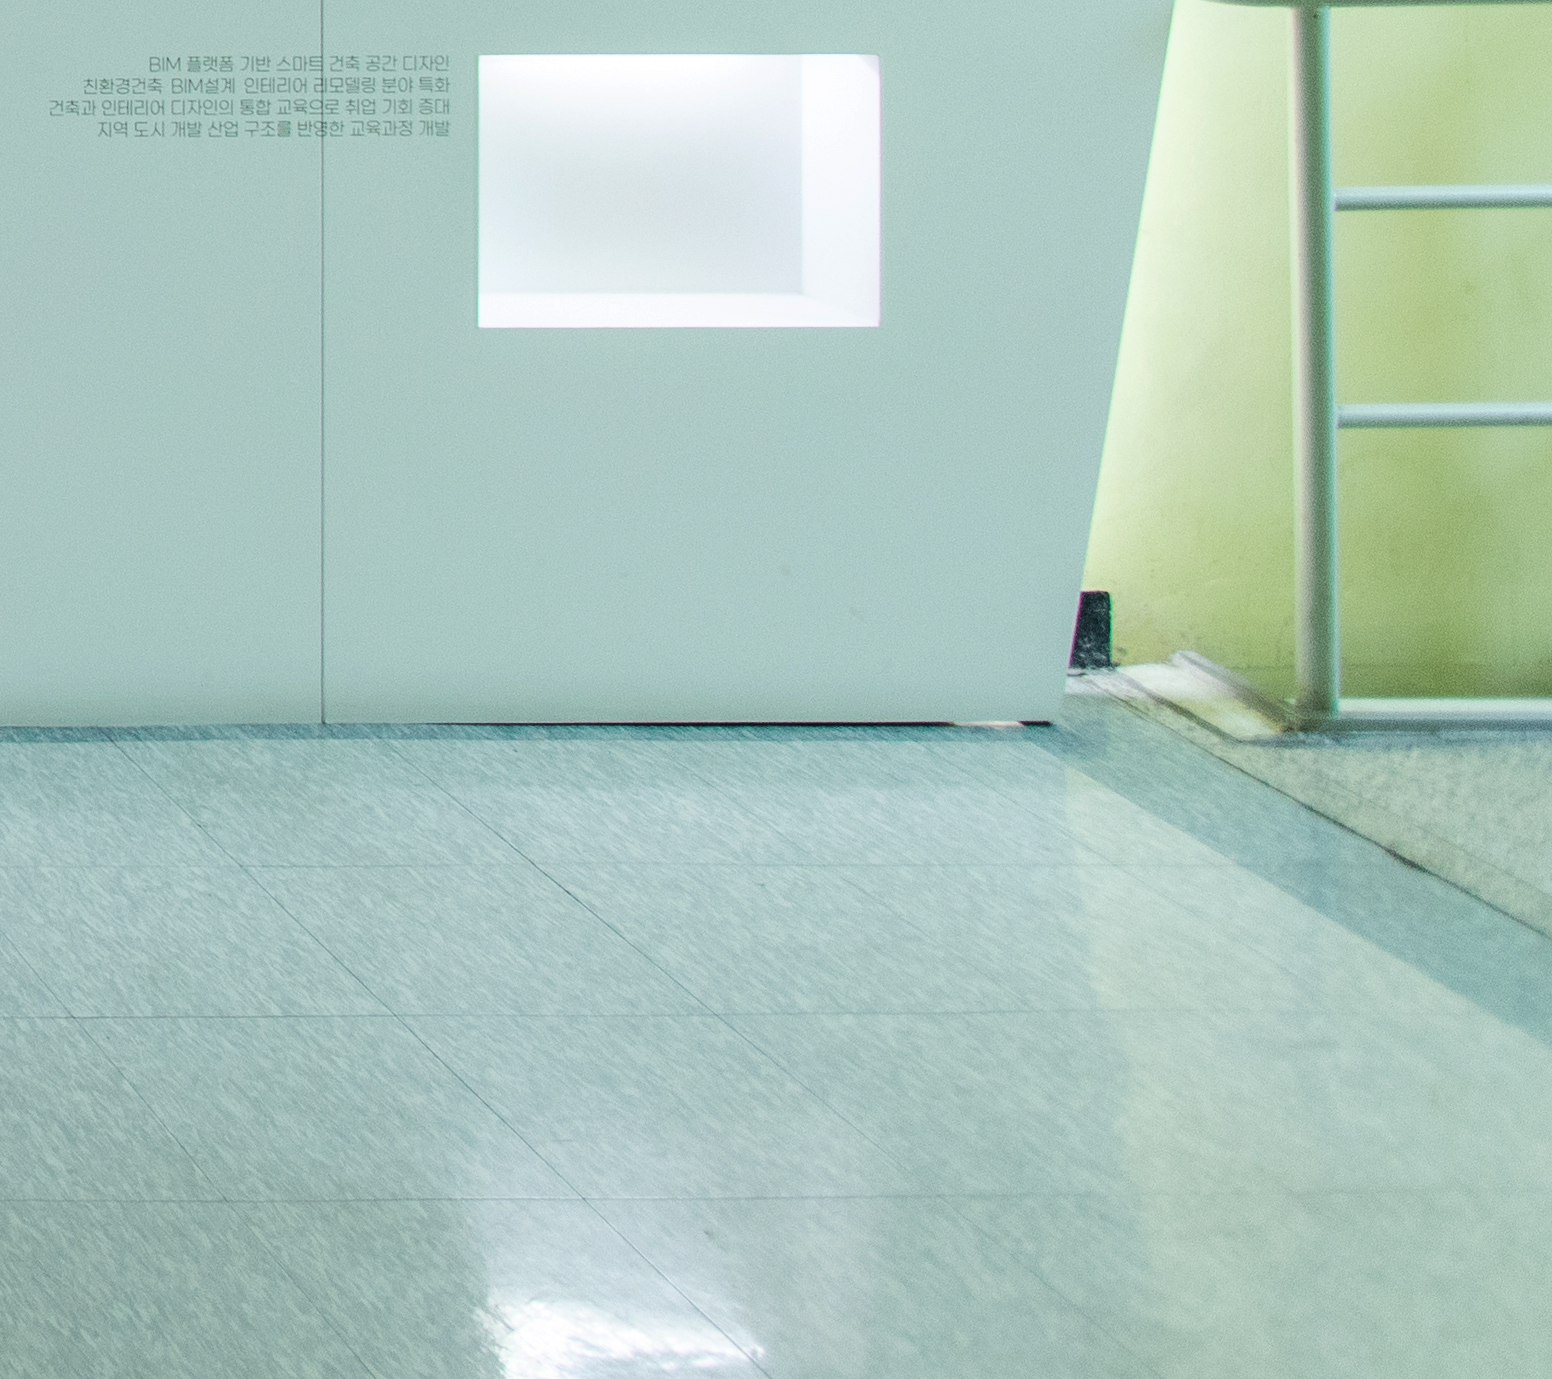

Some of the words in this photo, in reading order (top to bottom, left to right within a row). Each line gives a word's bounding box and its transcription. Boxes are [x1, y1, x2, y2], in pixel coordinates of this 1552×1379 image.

[149, 56, 181, 72] BIM
[187, 56, 233, 72] 플랫폼
[241, 56, 271, 72] 기반
[277, 55, 324, 72] 스마트
[330, 55, 360, 72] 건축
[366, 55, 397, 72] 공간
[403, 55, 449, 72] 디자인
[84, 78, 162, 94] 친환경건축
[171, 78, 235, 94] BIM설계
[244, 77, 307, 94] 인테리어
[314, 77, 376, 94] 리모델링
[382, 77, 413, 94] 분야
[419, 77, 450, 92] 특화
